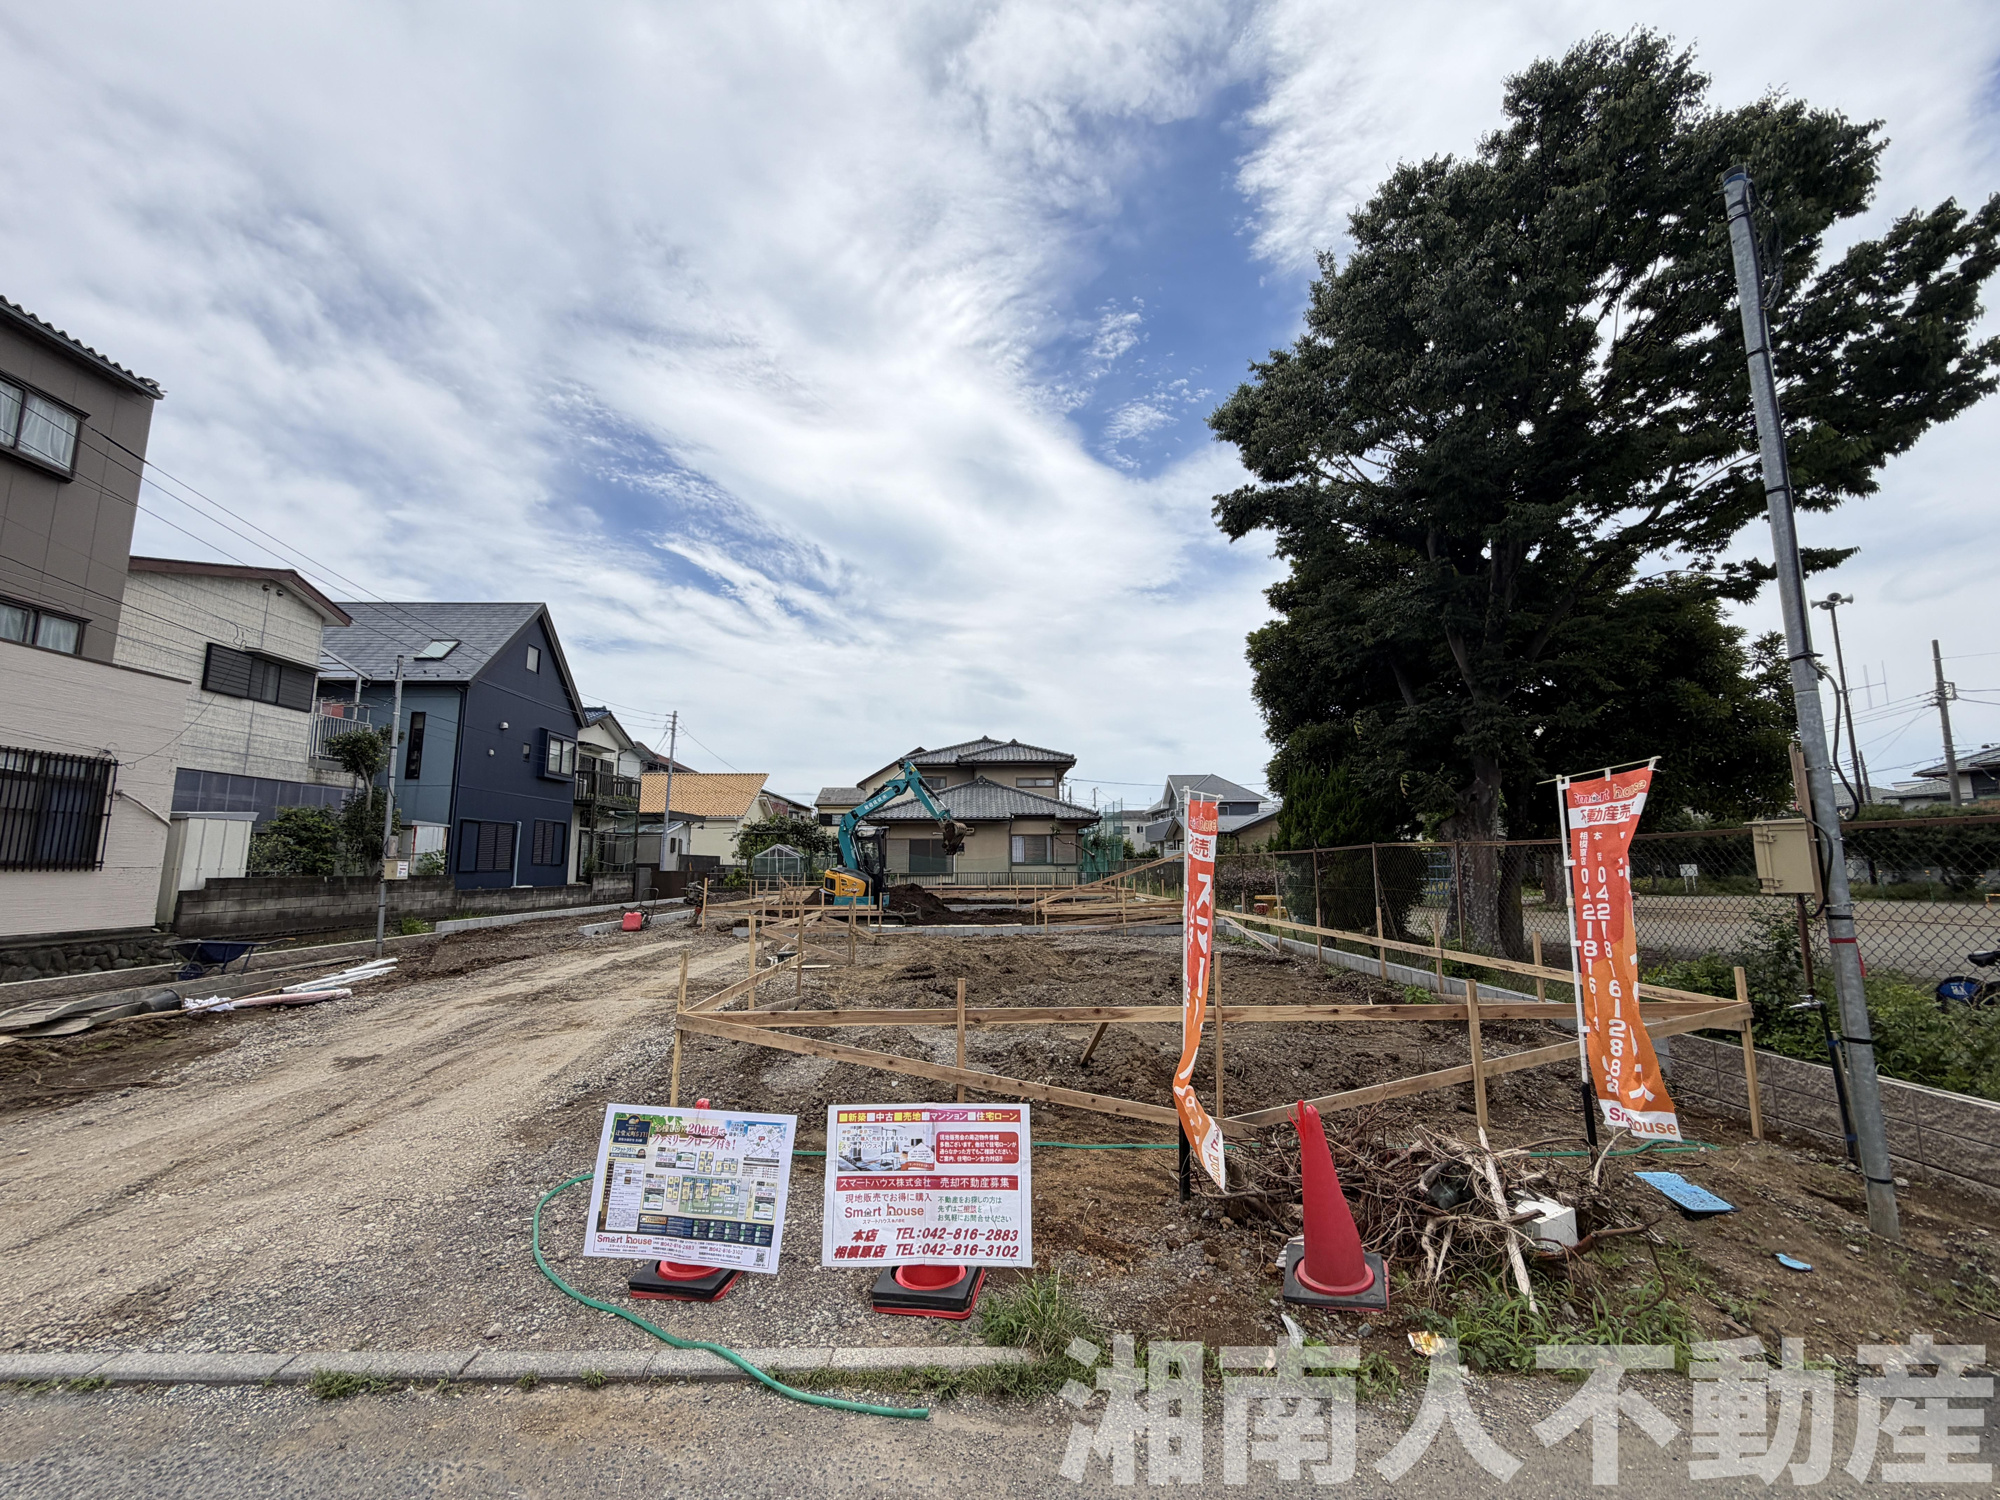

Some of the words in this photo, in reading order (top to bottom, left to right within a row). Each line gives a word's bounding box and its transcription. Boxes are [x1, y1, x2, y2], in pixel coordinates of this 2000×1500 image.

[875, 1112, 893, 1122] 中古
[902, 1111, 921, 1122] 売地
[930, 1112, 968, 1121] マンション
[976, 1111, 1018, 1122] 住宅ローン
[840, 1178, 931, 1188] スマートハウス株式会社
[940, 1177, 1010, 1188] 売却不動産募集
[844, 1192, 932, 1204] 現地販売でお得に購入
[937, 1196, 1002, 1204] 不動産をお探しの方は
[844, 1206, 882, 1218] Smart
[886, 1203, 924, 1216] house
[597, 1234, 623, 1244] Smart
[625, 1234, 653, 1246] house
[851, 1229, 879, 1243] 本店
[834, 1245, 888, 1260] 相模原店
